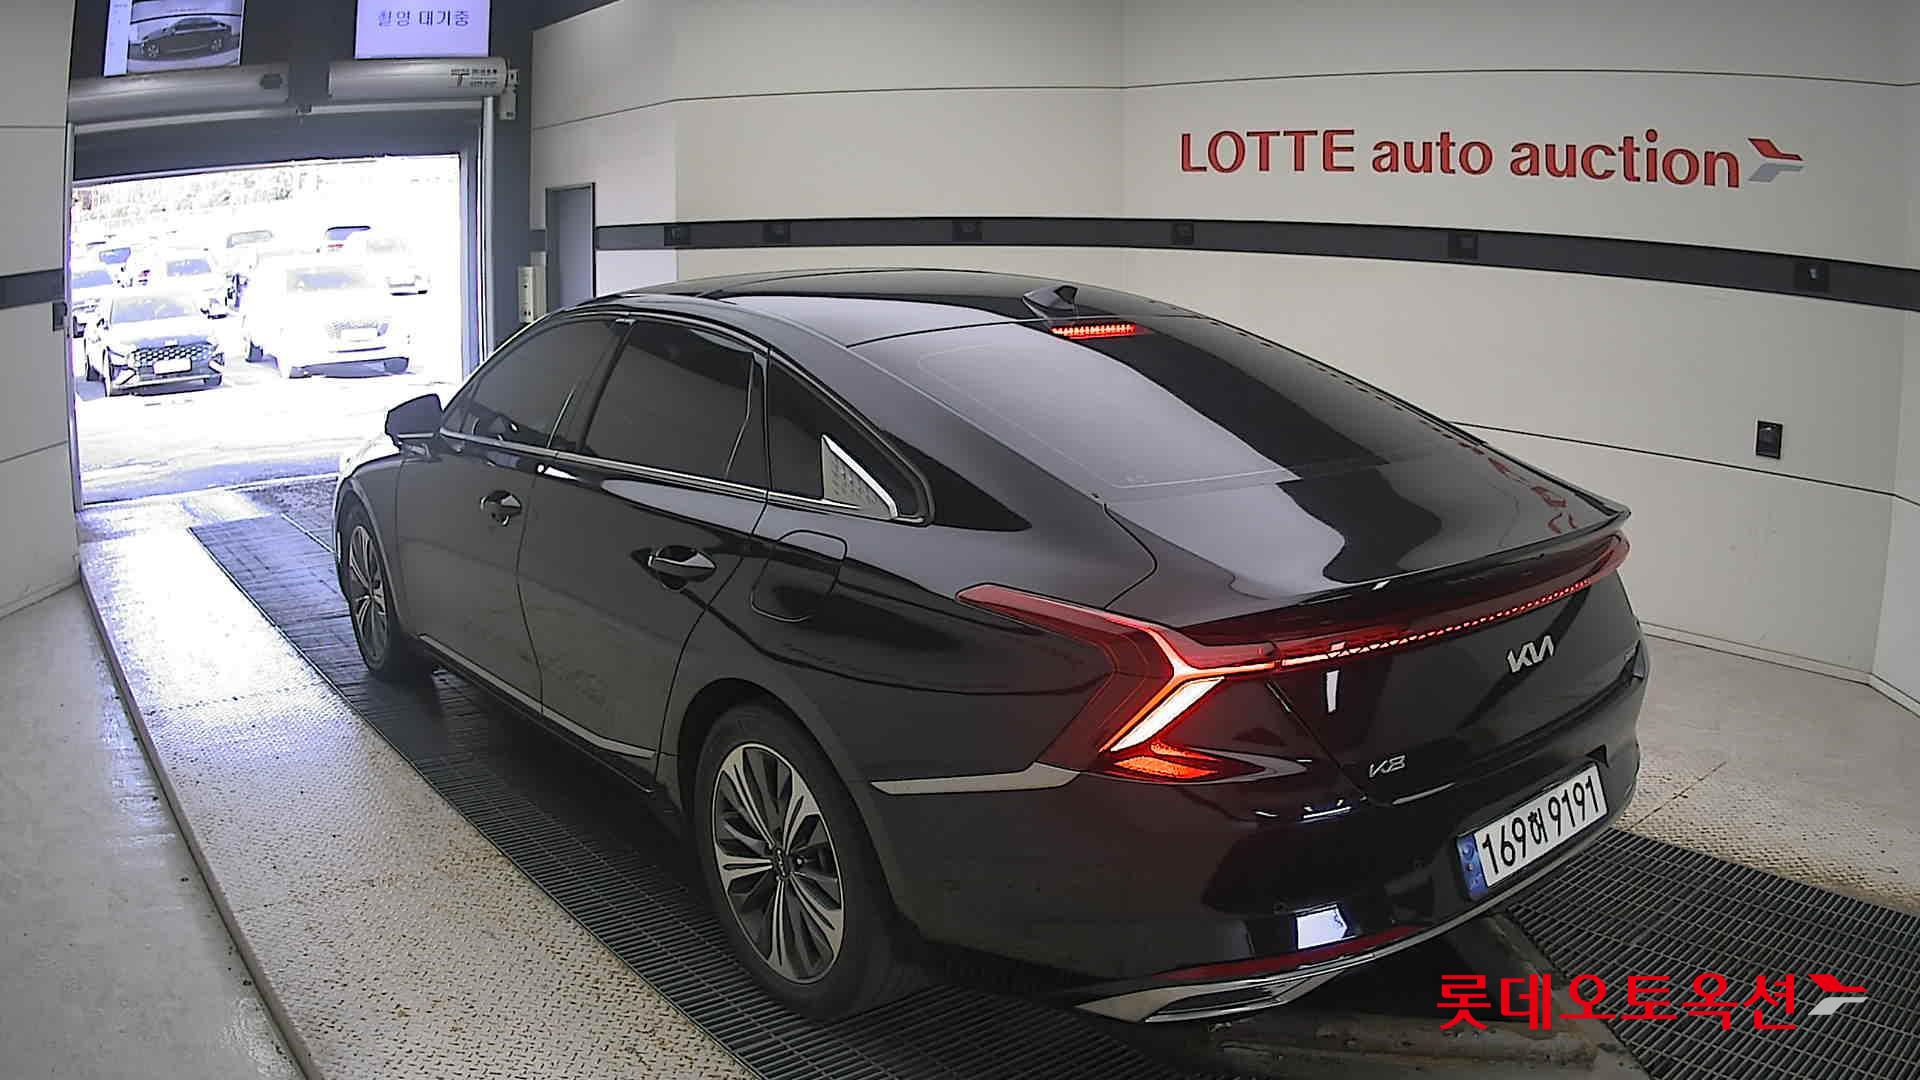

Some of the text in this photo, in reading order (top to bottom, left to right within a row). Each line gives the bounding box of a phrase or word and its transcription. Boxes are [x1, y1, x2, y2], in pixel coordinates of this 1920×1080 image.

[419, 10, 470, 27] 대기중
[1180, 128, 1740, 189] LOTTE auto auction
[1368, 754, 1407, 778] K8
